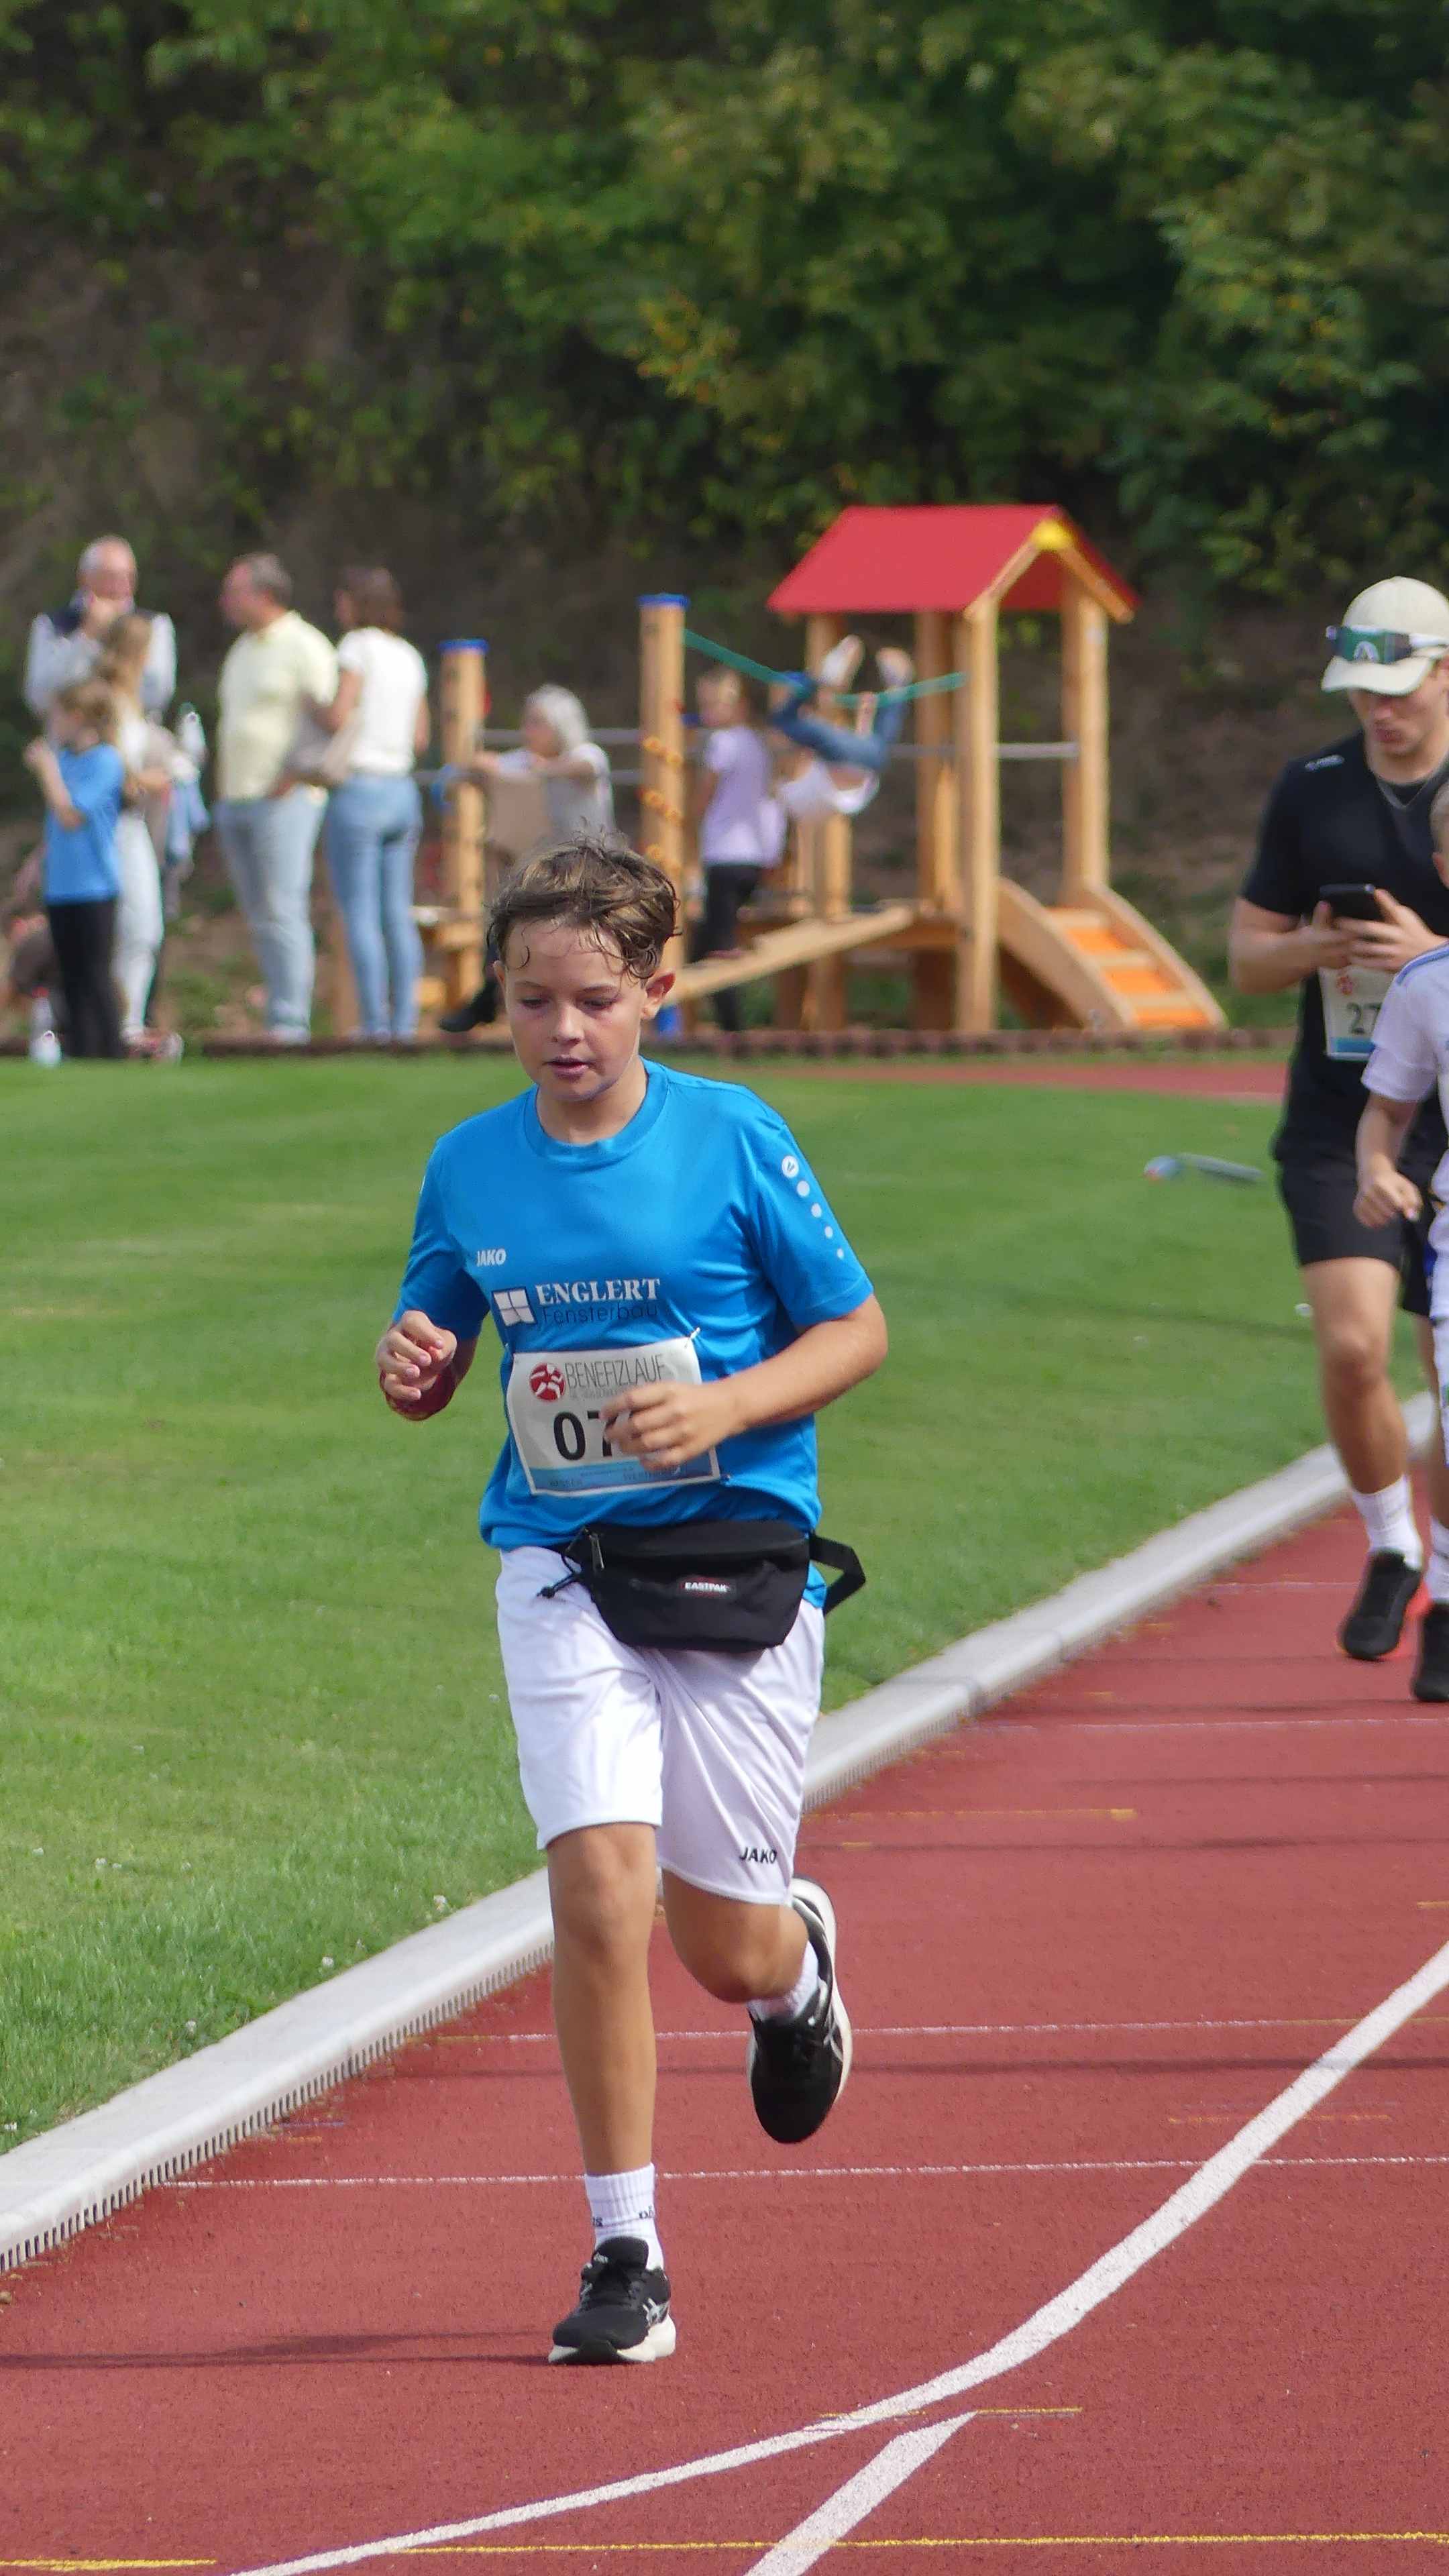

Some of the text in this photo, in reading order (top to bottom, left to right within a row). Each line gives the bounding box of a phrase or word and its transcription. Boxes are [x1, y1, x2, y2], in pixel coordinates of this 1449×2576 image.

[477, 1248, 506, 1267] JAKO
[535, 1277, 660, 1305] ENGLERT
[541, 1301, 658, 1324] Fensterbau
[564, 1354, 665, 1389] BENEFIZLAUF
[685, 1582, 730, 1593] EASTPAK
[739, 1847, 777, 1864] JAKO
